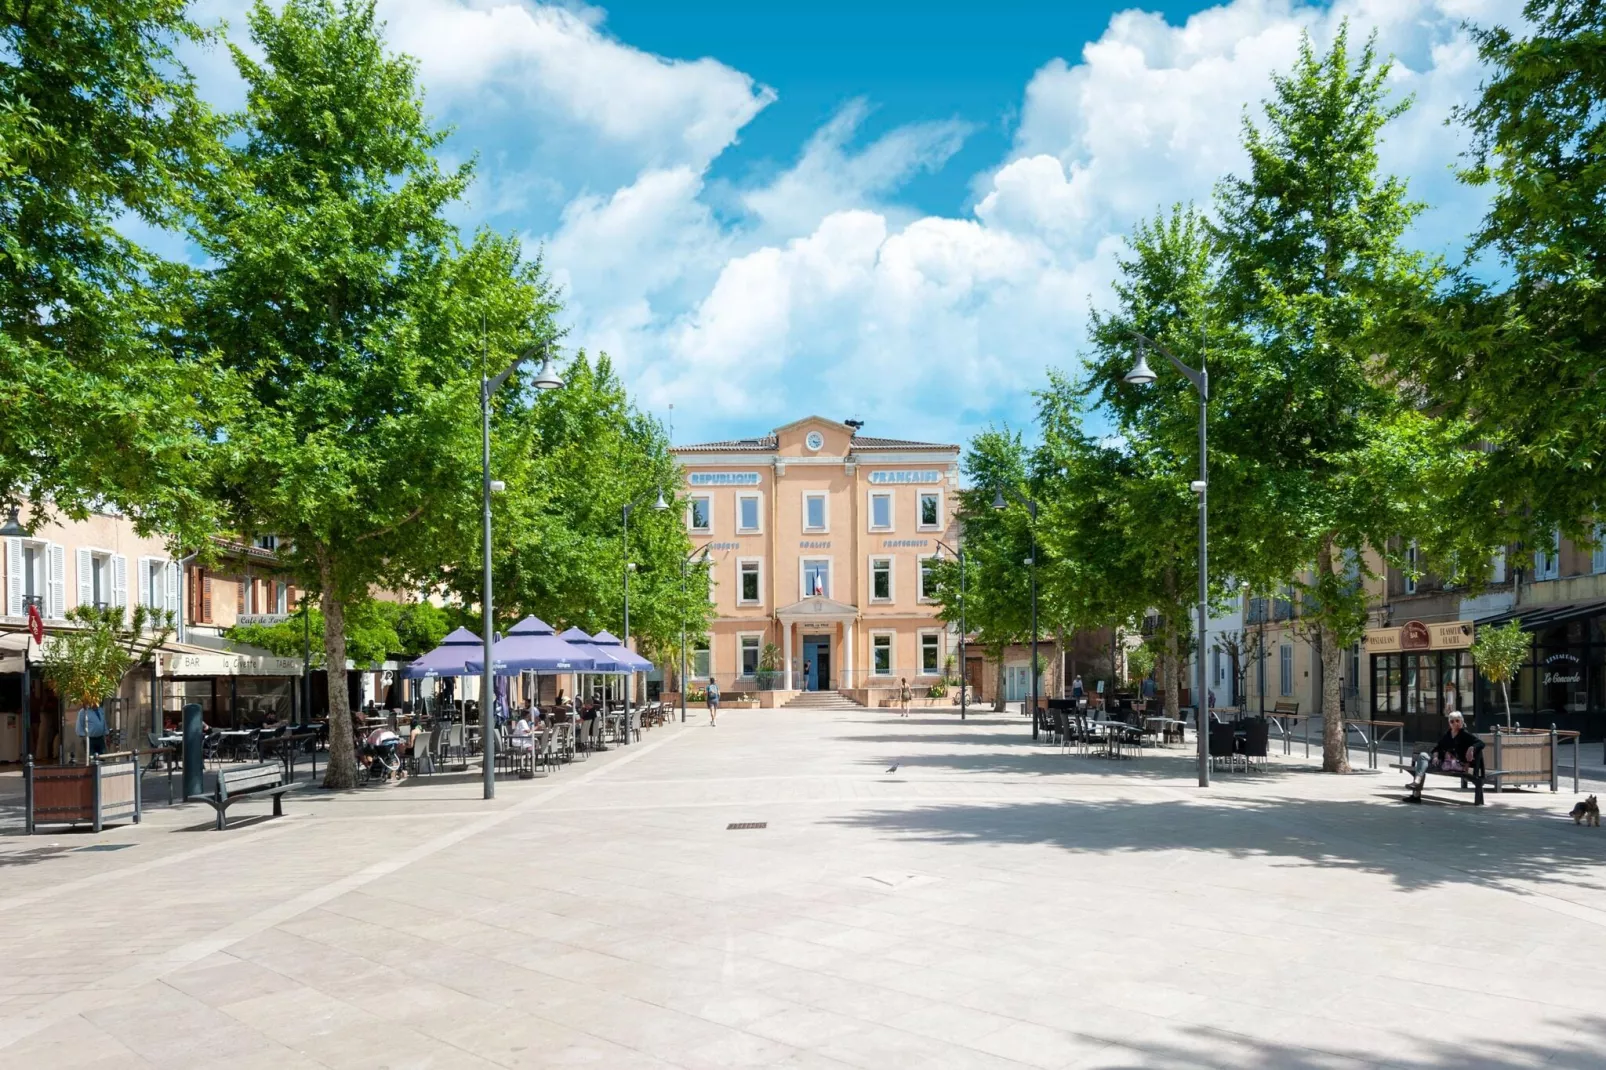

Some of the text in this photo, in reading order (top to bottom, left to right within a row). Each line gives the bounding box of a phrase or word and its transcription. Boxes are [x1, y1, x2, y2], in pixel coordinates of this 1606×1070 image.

[240, 616, 257, 626] Café
[258, 616, 267, 624] de
[185, 656, 200, 667] BAR
[1542, 672, 1581, 685] Le Concorde
